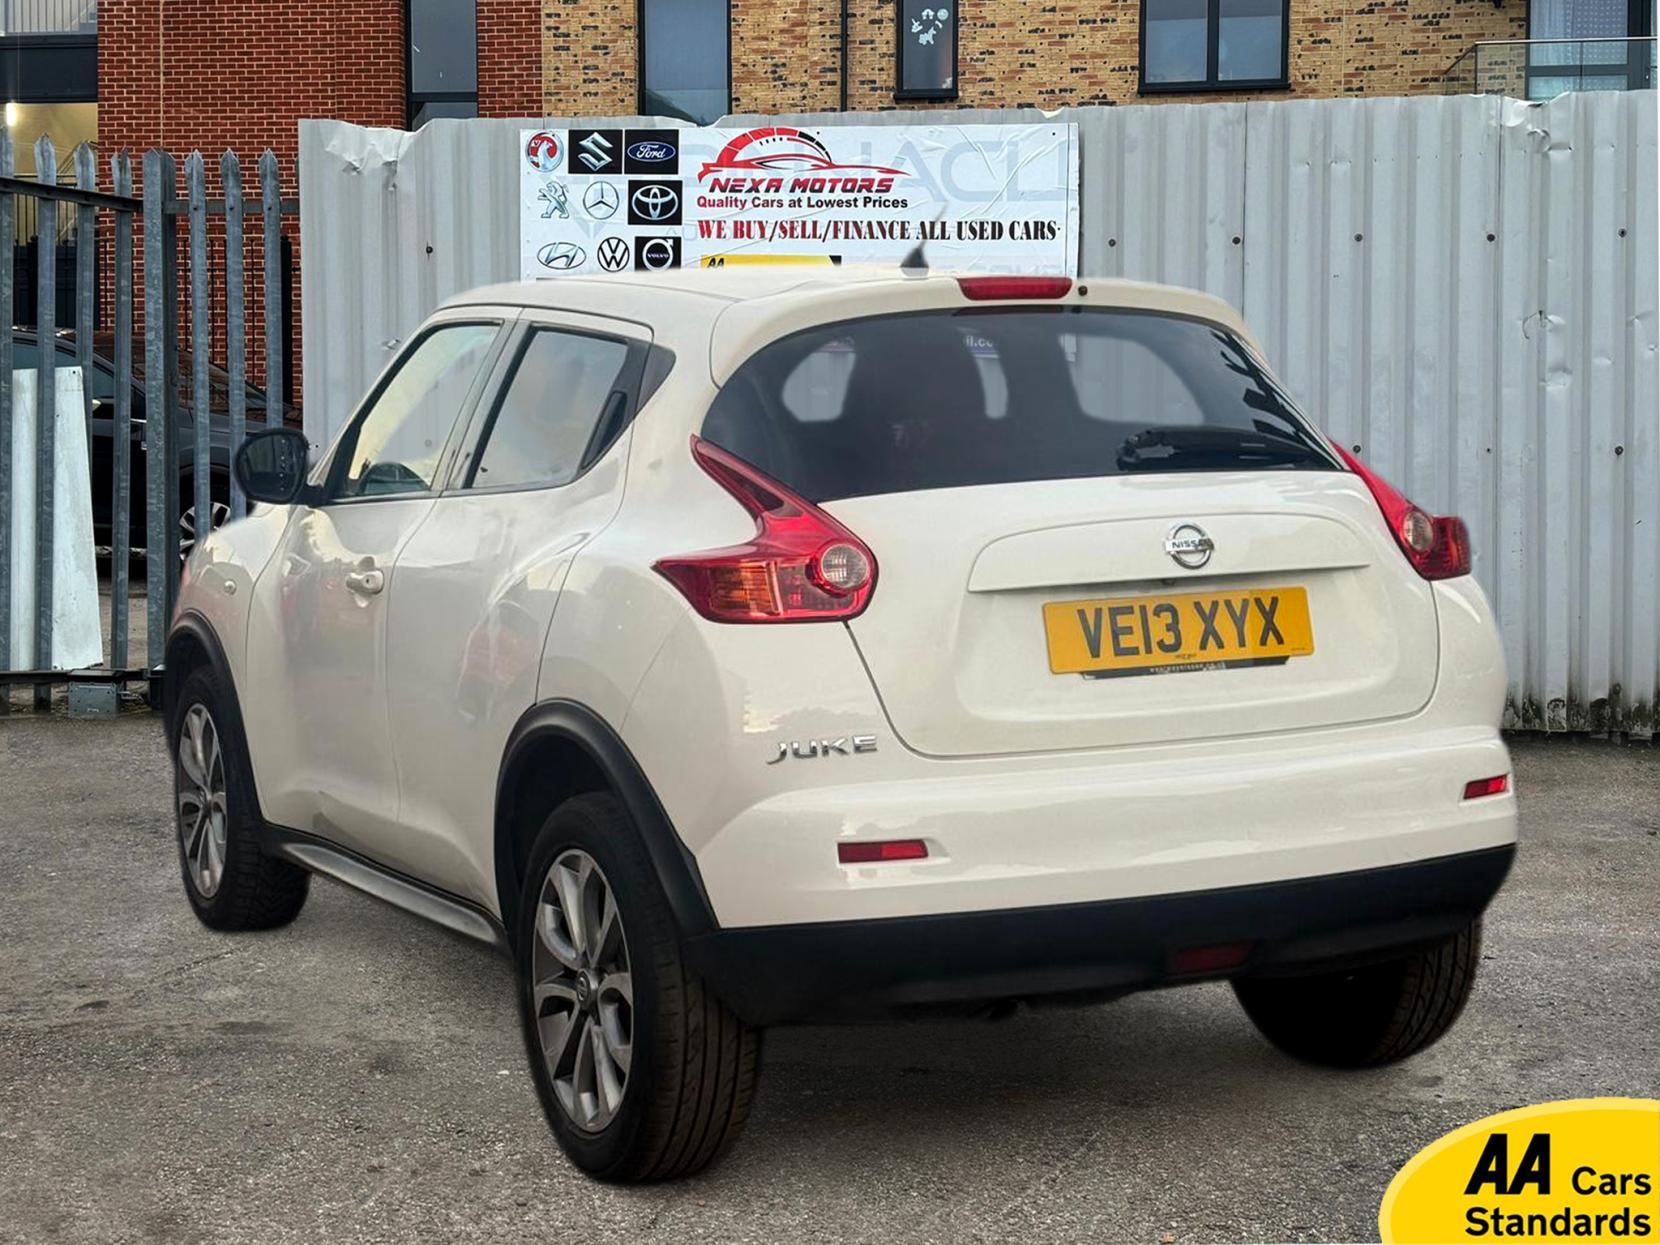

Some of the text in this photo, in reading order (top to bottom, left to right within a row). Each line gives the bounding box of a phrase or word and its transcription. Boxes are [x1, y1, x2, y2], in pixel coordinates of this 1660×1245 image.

[636, 143, 666, 159] Ford
[708, 177, 895, 194] NEXA MOTORS
[697, 196, 908, 211] Quality Cars at Lowest Prices
[697, 220, 727, 240] WE
[732, 220, 911, 243] BUY/SELL/FINANCE
[916, 220, 951, 241] ALL
[956, 220, 1004, 241] USED
[1009, 220, 1057, 241] CARS
[1077, 596, 1285, 659] VE13 XYX
[766, 735, 878, 765] JUKE
